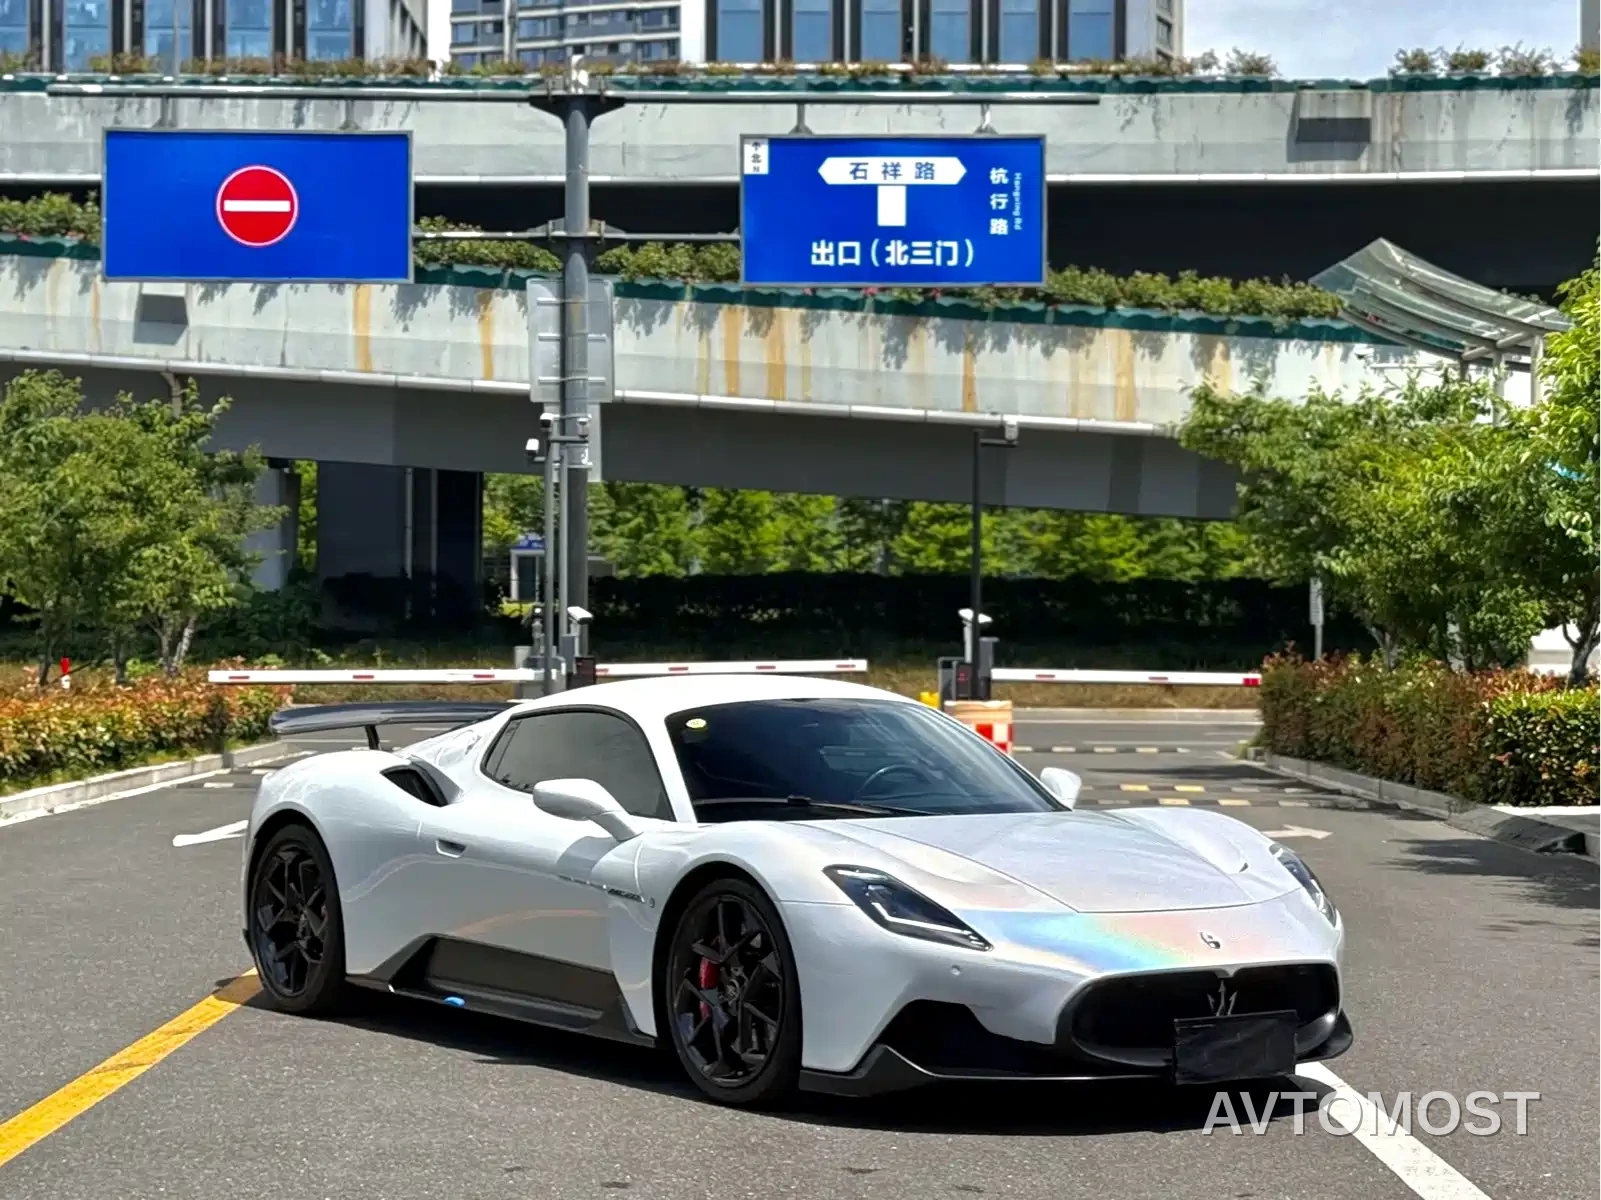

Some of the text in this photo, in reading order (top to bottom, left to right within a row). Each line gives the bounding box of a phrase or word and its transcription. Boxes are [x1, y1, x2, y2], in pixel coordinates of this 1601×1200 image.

[751, 153, 762, 164] 北
[849, 162, 936, 181] 石祥路
[989, 167, 1009, 236] 杭行路
